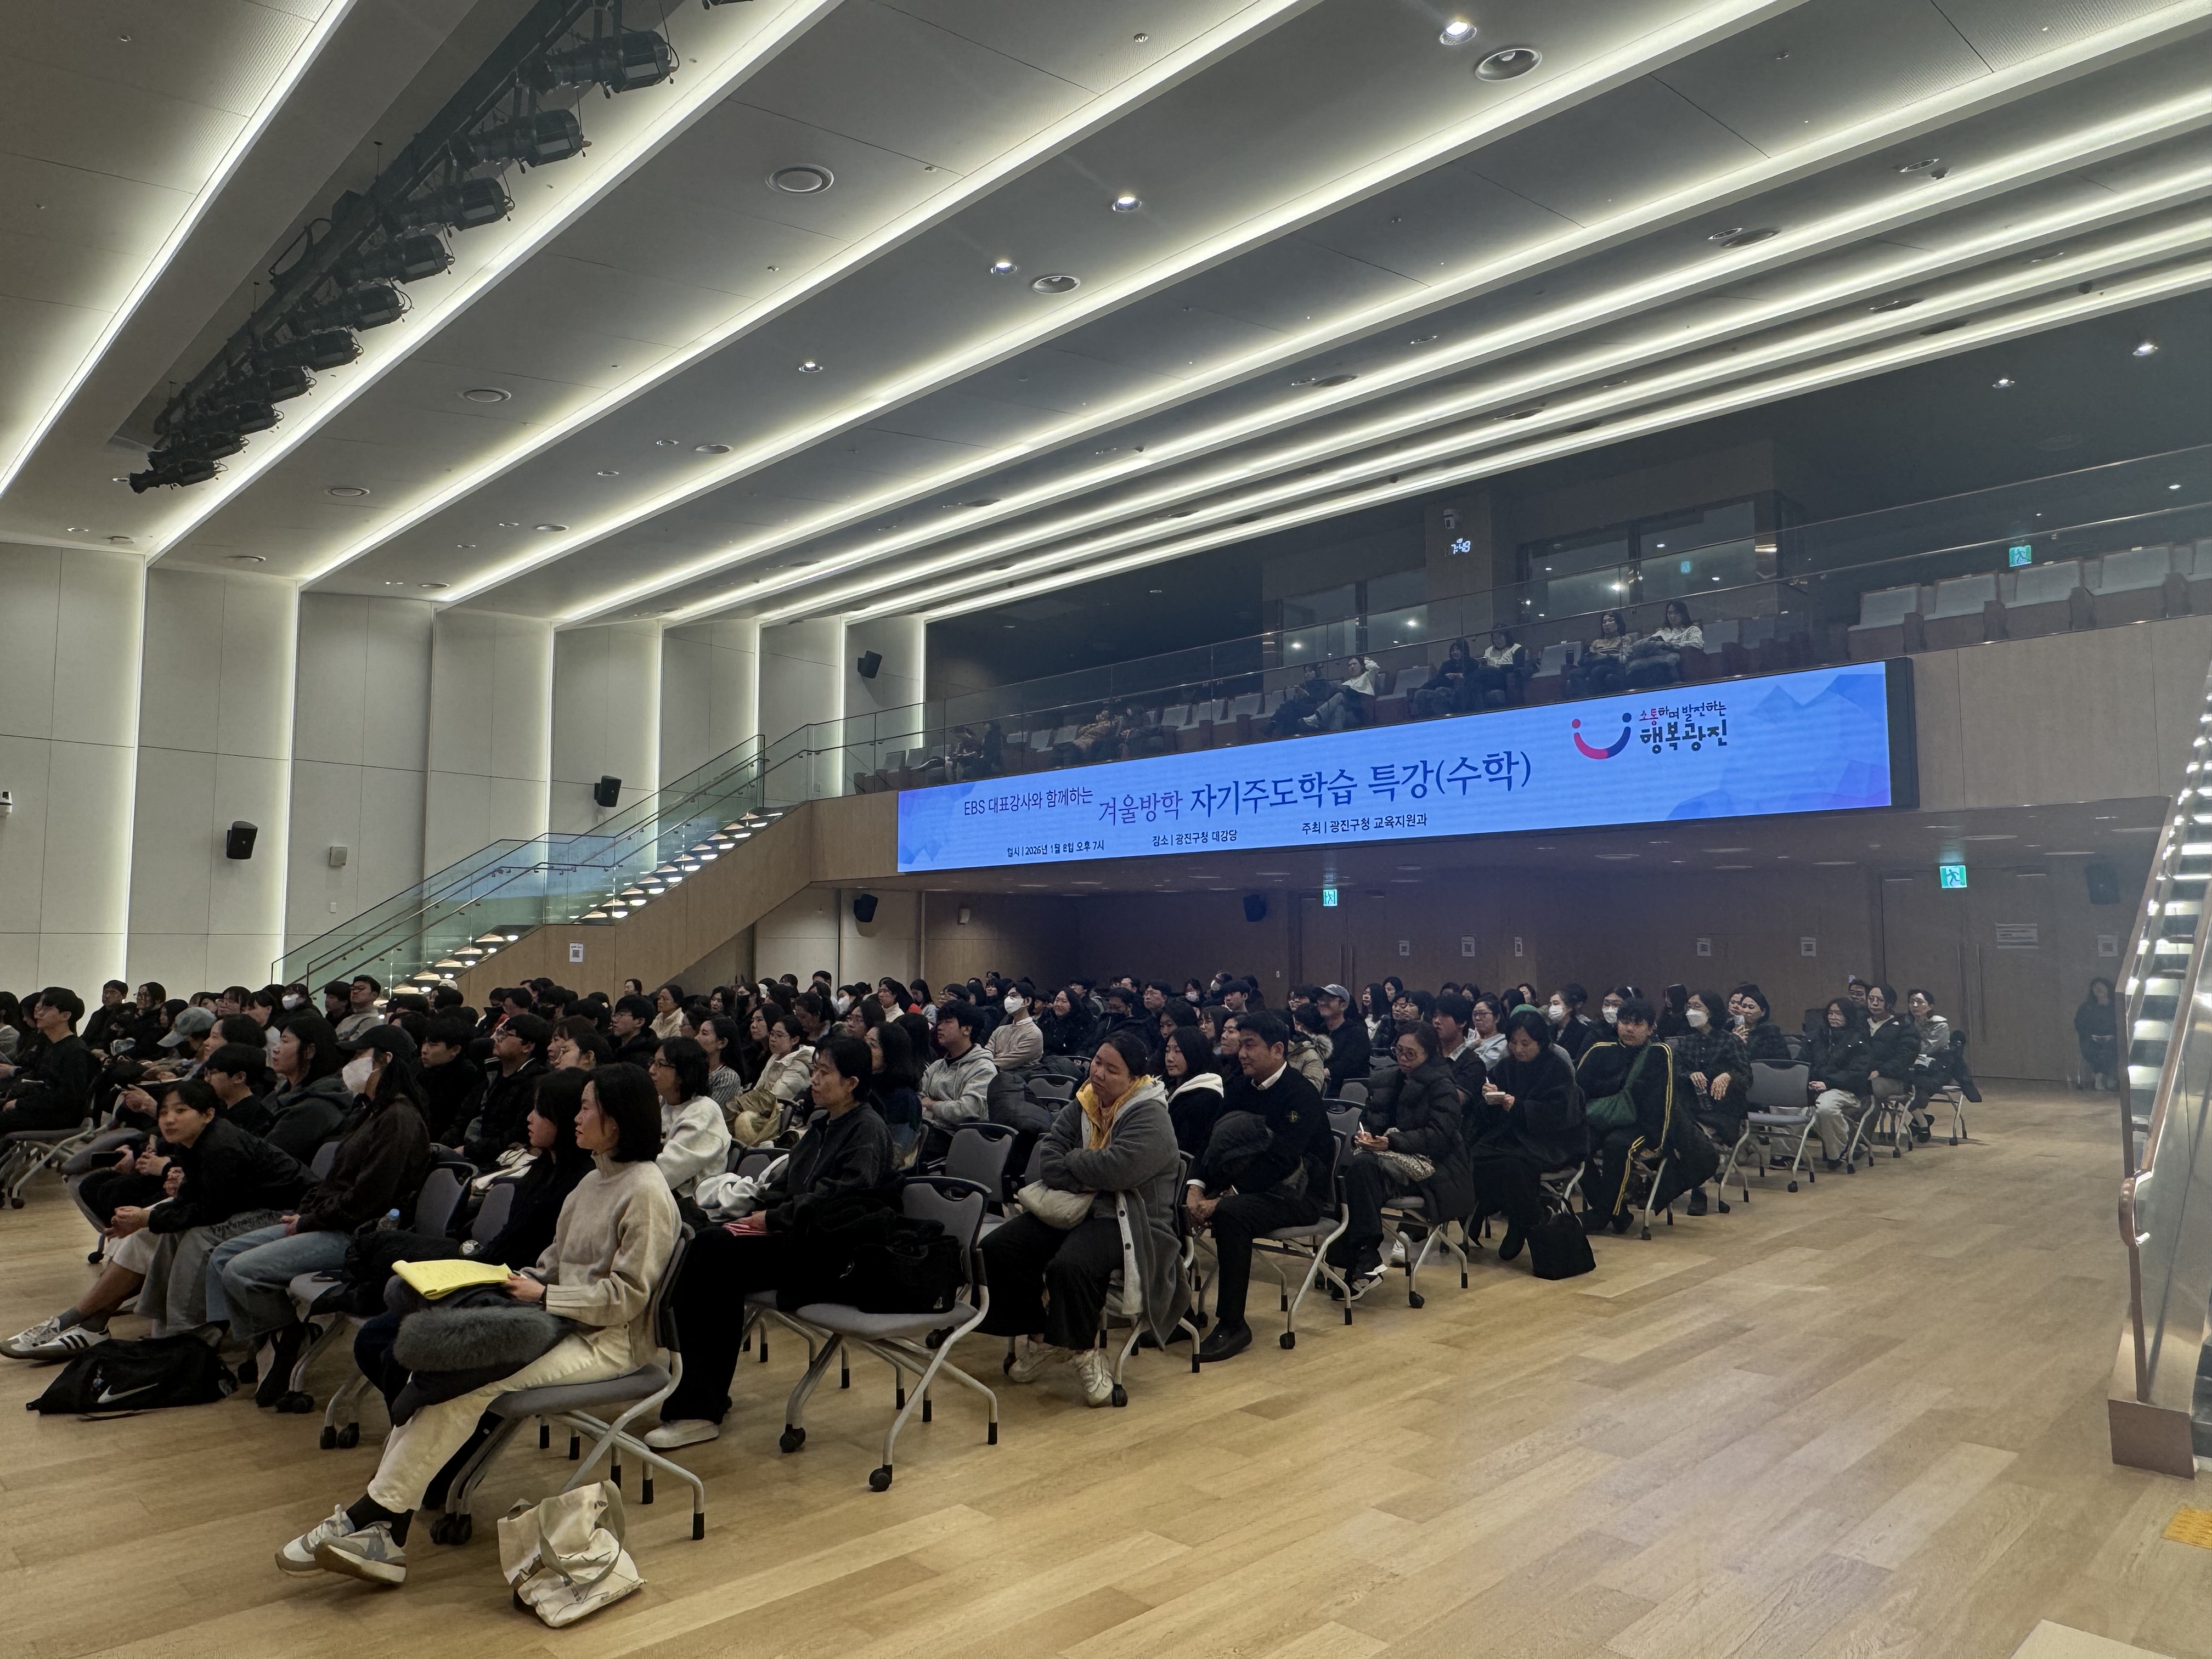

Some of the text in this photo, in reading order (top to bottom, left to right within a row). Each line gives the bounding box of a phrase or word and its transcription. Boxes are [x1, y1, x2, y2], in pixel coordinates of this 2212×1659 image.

[1639, 701, 1726, 726] 소통하며 발전하는
[1640, 719, 1728, 754] 행복광진
[964, 786, 1093, 815] EBS 대표강사와 함께하는
[1098, 751, 1531, 826] 겨울방학 자기주도학습 특강(수학)
[1302, 821, 1321, 835] 주최
[1330, 817, 1370, 833] 광진구청
[1373, 812, 1427, 828] 교육지원과
[1025, 844, 1048, 855] 2026년
[1076, 840, 1091, 852] 오후
[1092, 839, 1104, 850] 7시
[1153, 834, 1169, 847] 장소
[1175, 831, 1209, 845] 광진구청
[1212, 829, 1238, 842] 대강당
